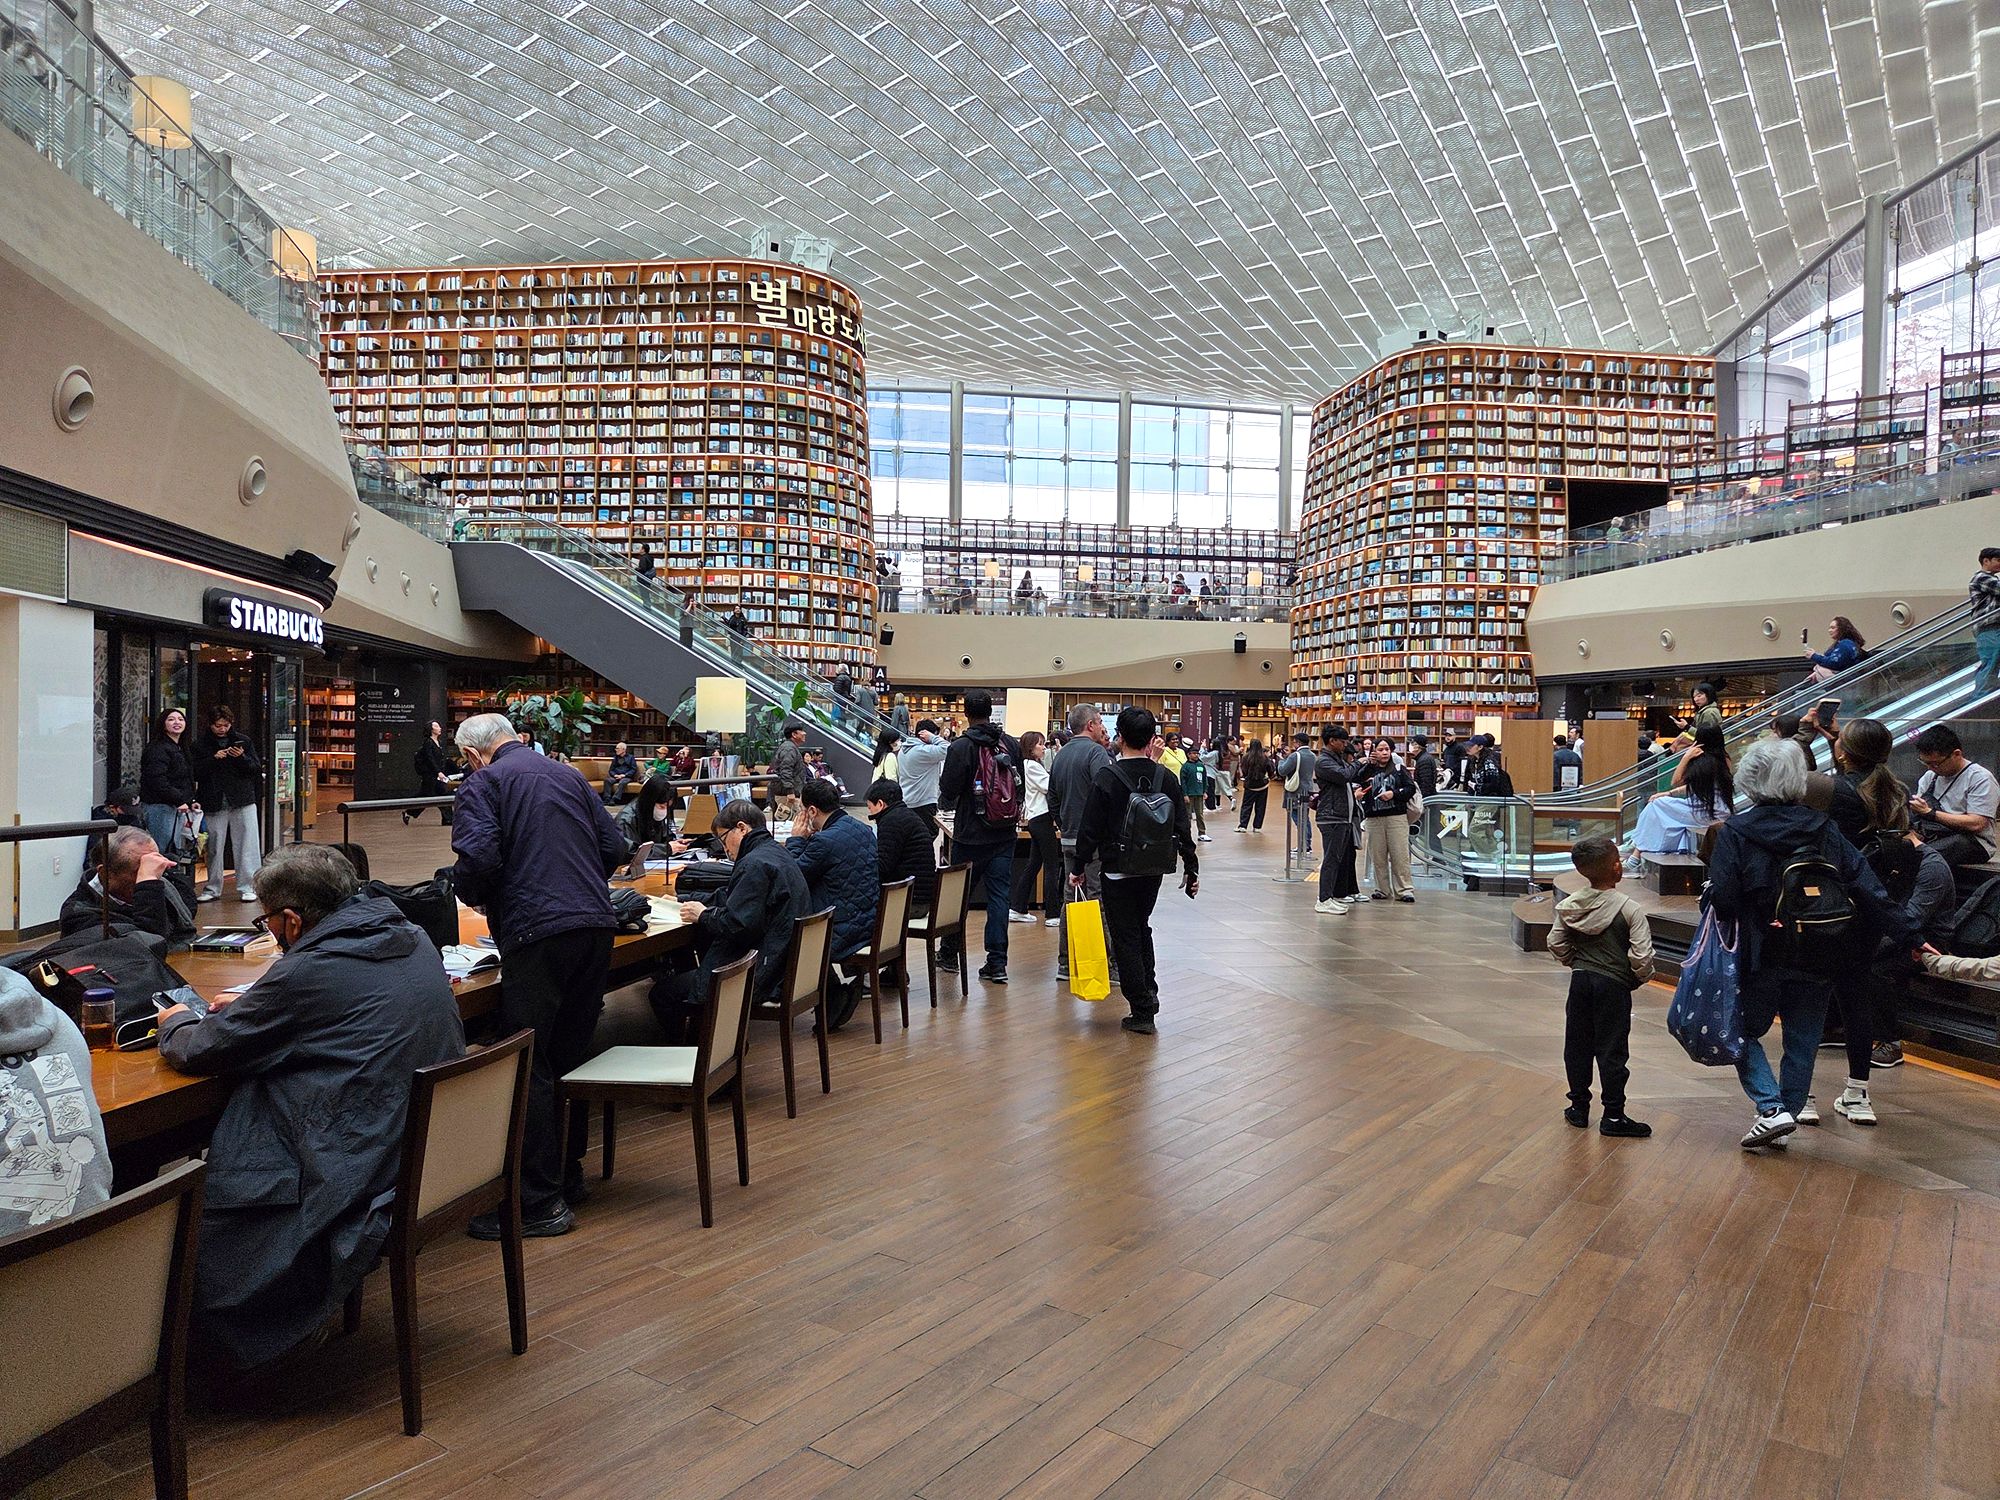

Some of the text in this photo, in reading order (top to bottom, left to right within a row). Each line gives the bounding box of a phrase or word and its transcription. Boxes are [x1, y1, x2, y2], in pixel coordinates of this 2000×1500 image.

[230, 597, 324, 645] STARBUCKS
[876, 667, 885, 678] A
[1347, 674, 1356, 685] B
